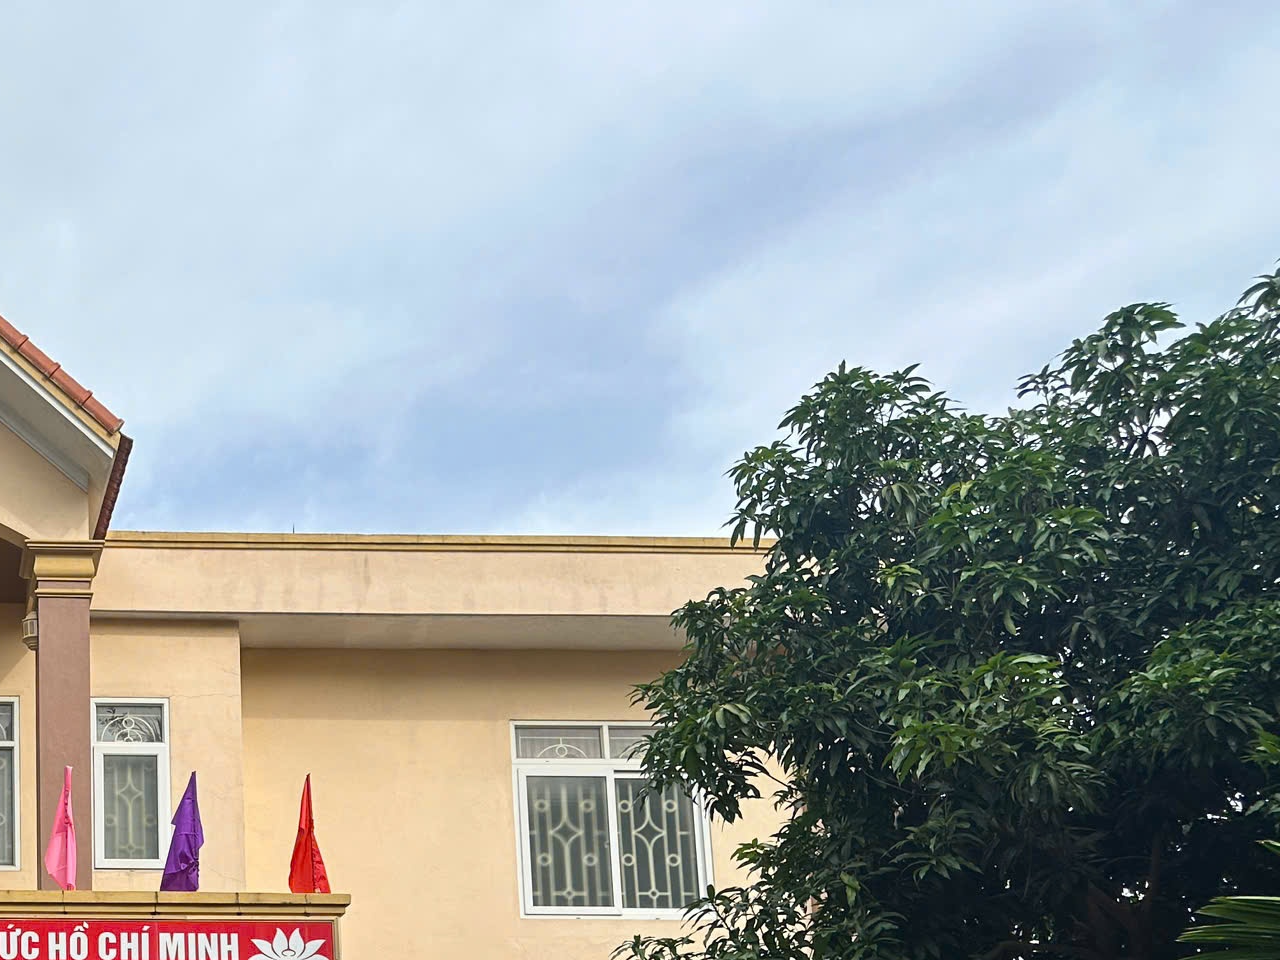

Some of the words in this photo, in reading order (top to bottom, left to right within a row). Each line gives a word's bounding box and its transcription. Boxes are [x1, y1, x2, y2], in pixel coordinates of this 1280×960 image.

[47, 921, 89, 960] HỒ
[98, 925, 150, 960] CHÍ
[159, 932, 239, 960] MINH
